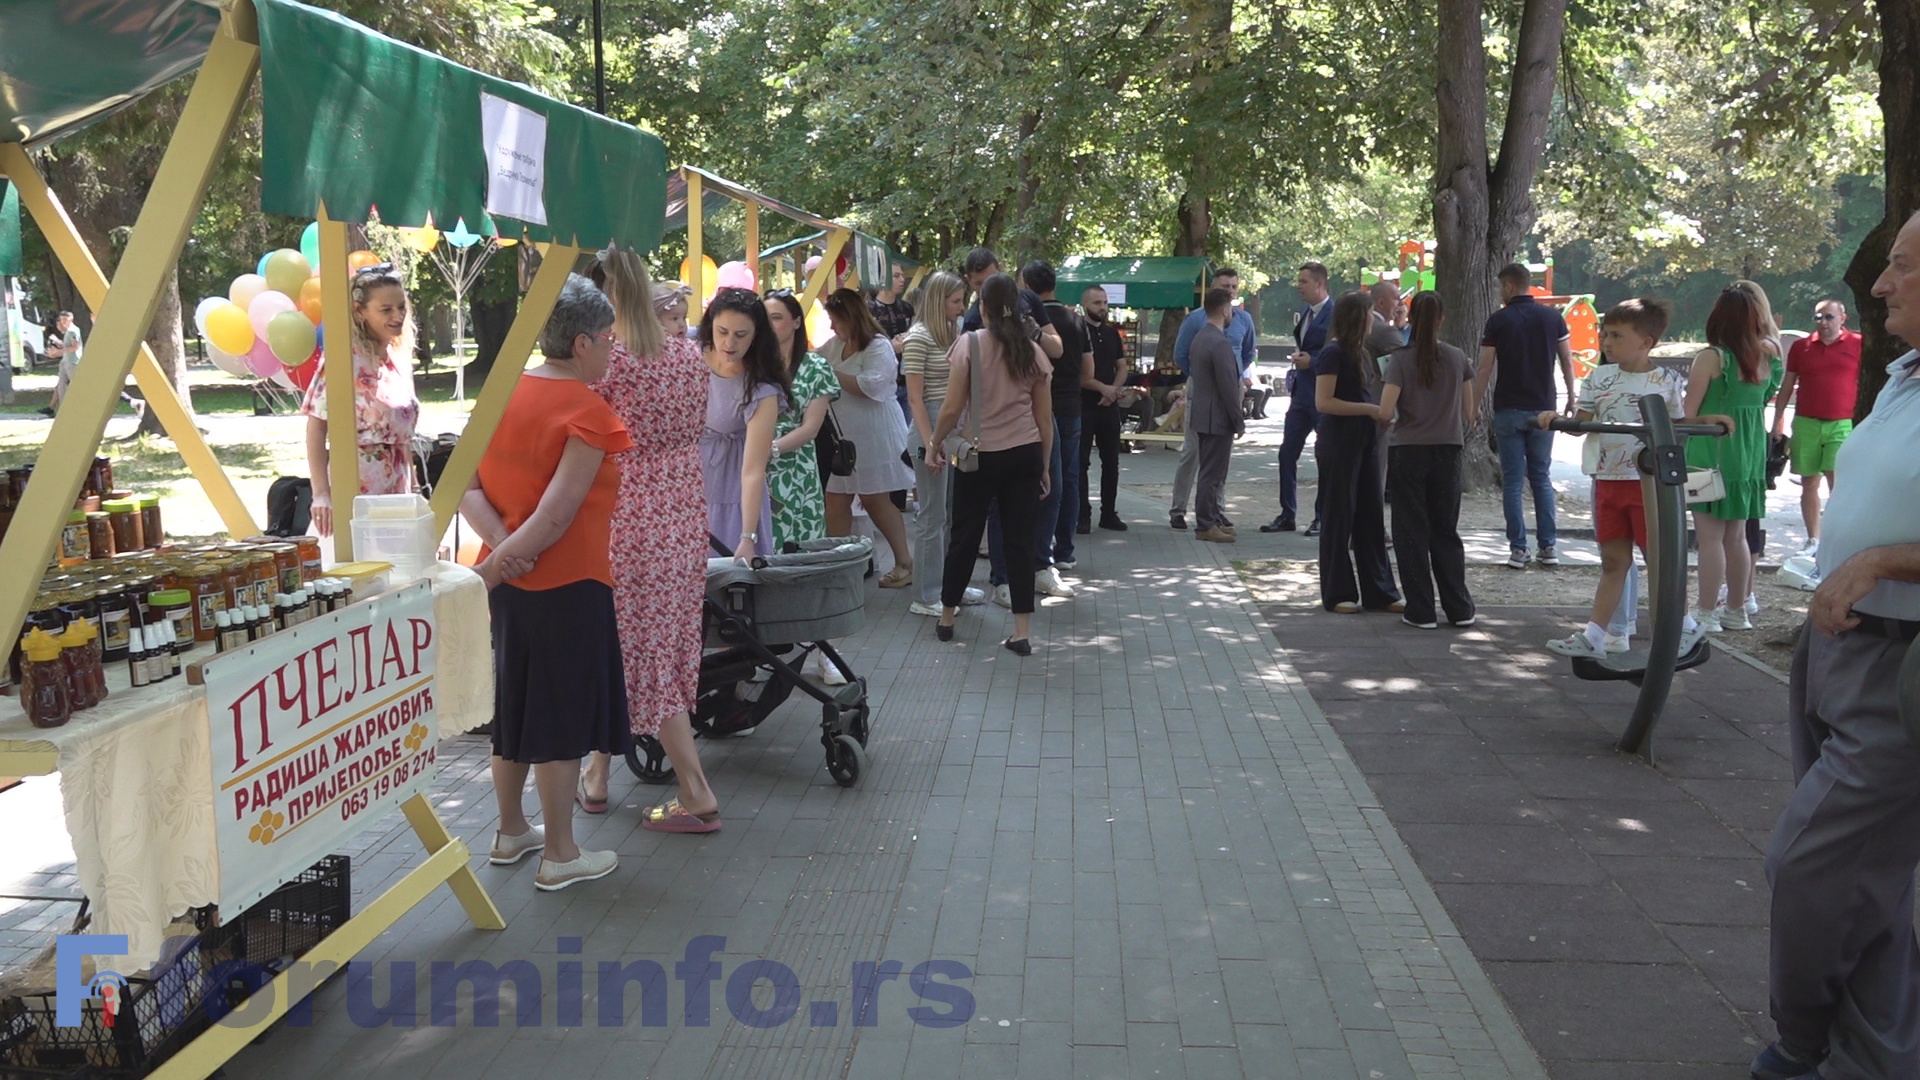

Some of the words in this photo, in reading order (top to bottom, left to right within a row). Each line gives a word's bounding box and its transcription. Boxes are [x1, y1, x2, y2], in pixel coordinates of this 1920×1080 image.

[228, 617, 433, 774] ПЧЕЛАР
[234, 743, 330, 821] РАДИША
[333, 687, 434, 764] ЖАРКОВИЋ
[288, 737, 402, 825] ПРИЈЕПОЉЕ
[341, 787, 369, 821] 063
[373, 774, 390, 800] 19
[393, 762, 409, 788] 08
[412, 746, 436, 776] 274
